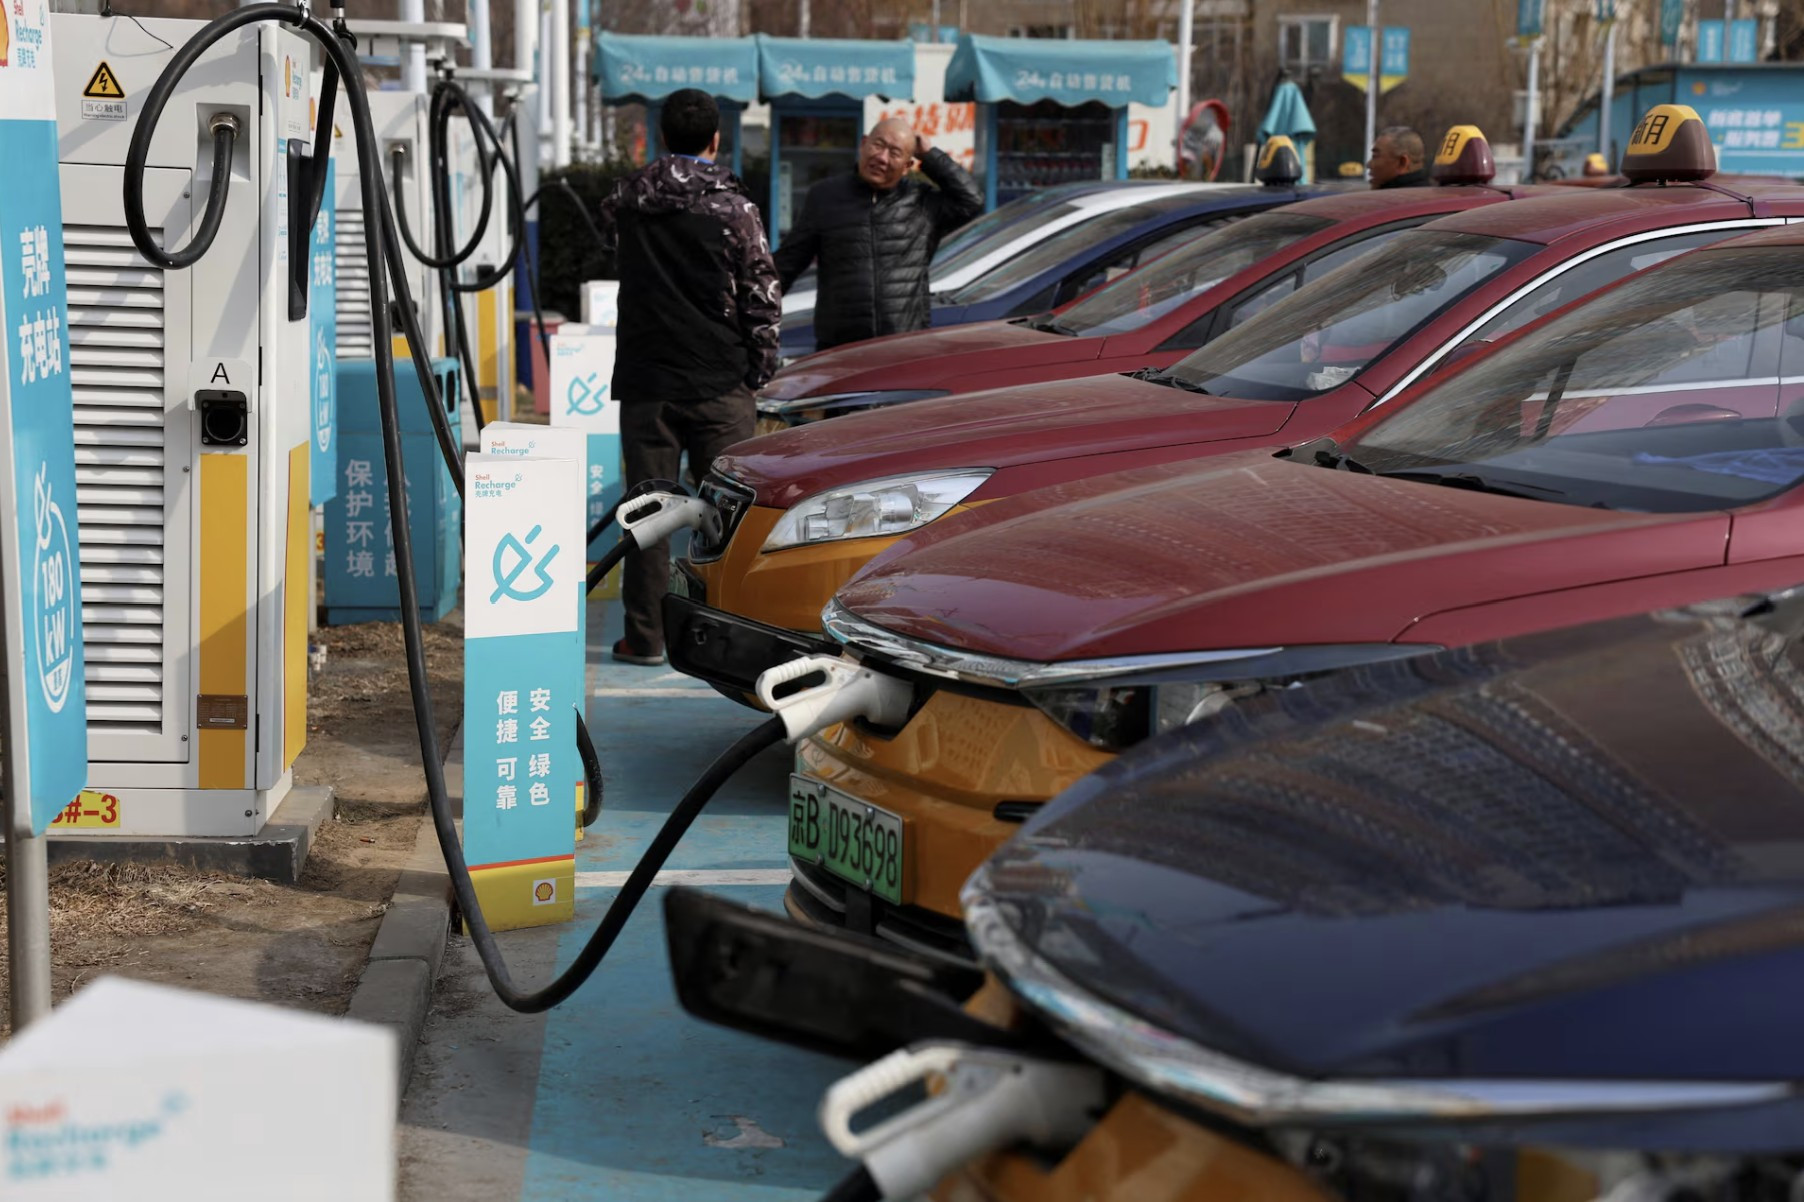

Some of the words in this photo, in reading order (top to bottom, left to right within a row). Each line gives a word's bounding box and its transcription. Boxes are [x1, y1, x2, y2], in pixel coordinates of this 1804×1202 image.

[85, 103, 123, 113] 当心触电
[19, 225, 51, 299] 壳牌
[19, 306, 62, 386] 充电站
[210, 362, 230, 384] A
[491, 447, 529, 456] Recharge
[475, 480, 516, 490] Recharge
[344, 459, 375, 577] 保护环境
[42, 551, 64, 610] 180
[44, 606, 67, 667] kW
[496, 690, 518, 744] 便捷
[529, 687, 551, 741] 安全
[496, 757, 518, 810] 可靠
[529, 753, 551, 806] 绿色
